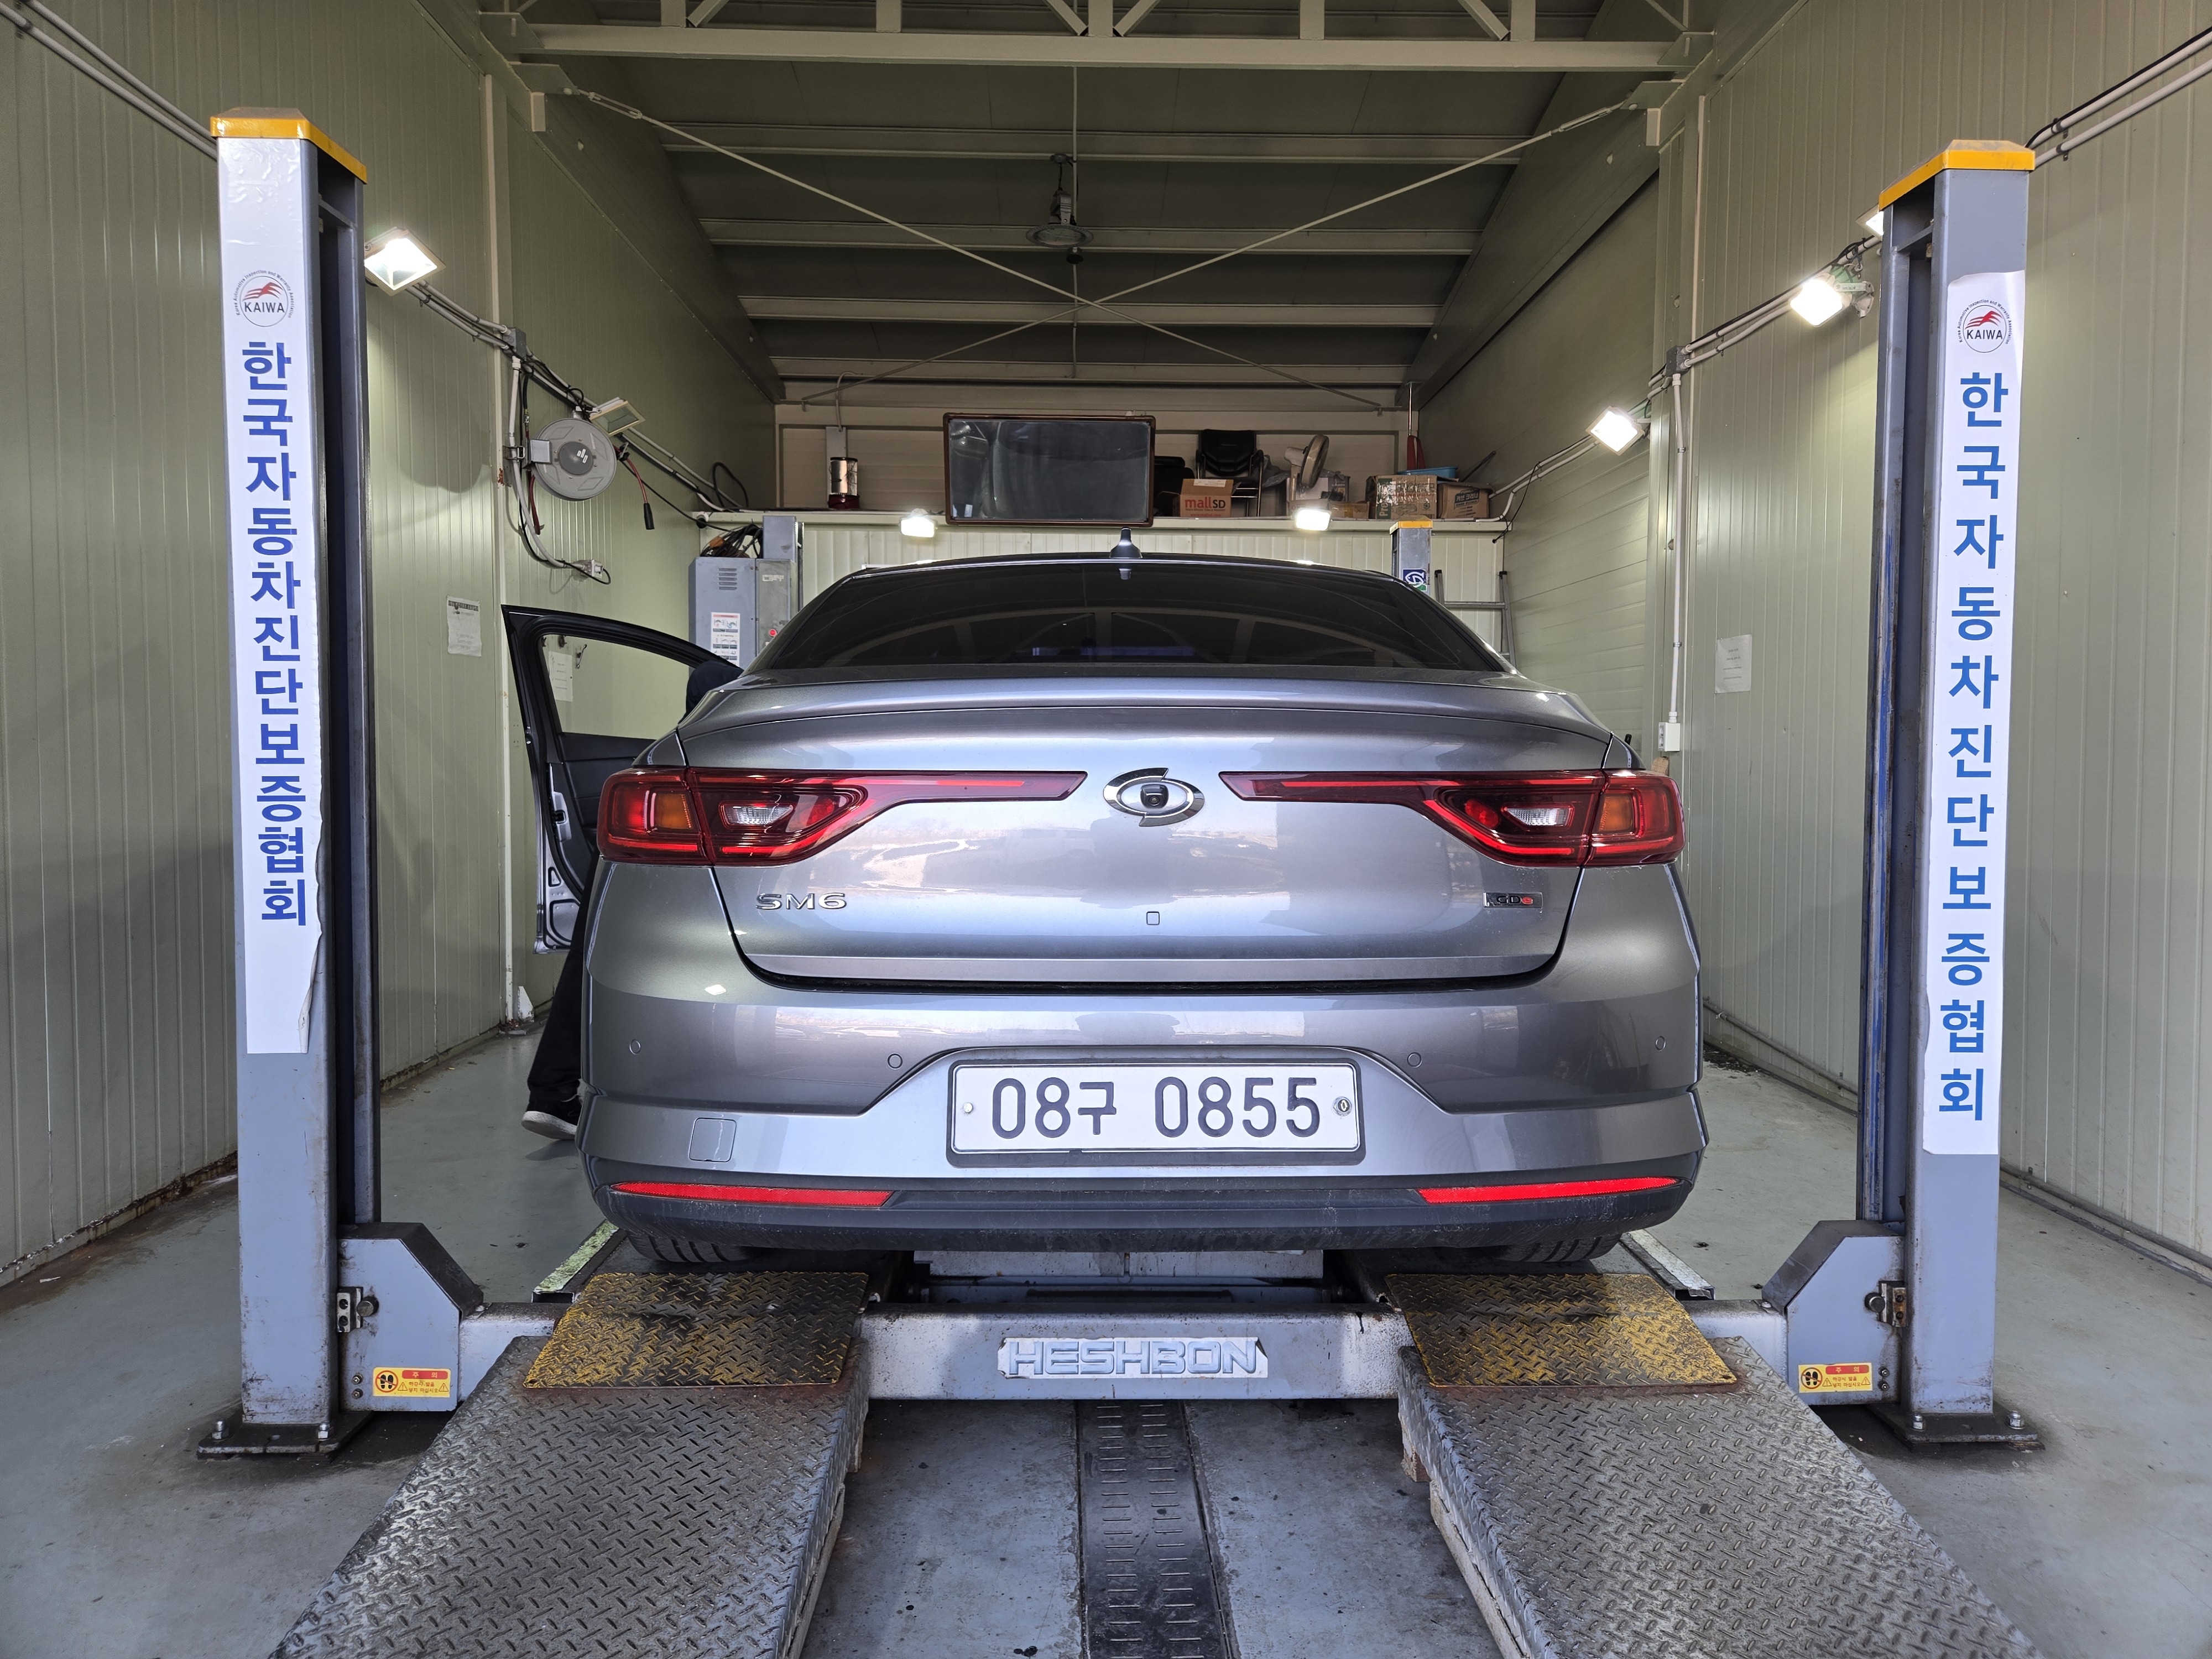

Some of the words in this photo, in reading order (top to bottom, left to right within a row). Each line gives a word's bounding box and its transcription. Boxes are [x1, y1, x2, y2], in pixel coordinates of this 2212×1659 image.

[244, 301, 285, 313] KAIWA
[1966, 329, 2003, 340] KAIWA
[242, 341, 306, 926] 한국자동차진단보증협회
[1938, 372, 2009, 1121] 한국자동차진단보증협회
[755, 892, 847, 910] SM6
[992, 1077, 1117, 1140] 08구
[1154, 1076, 1321, 1138] 0855
[1009, 1340, 1257, 1375] HESHBON
